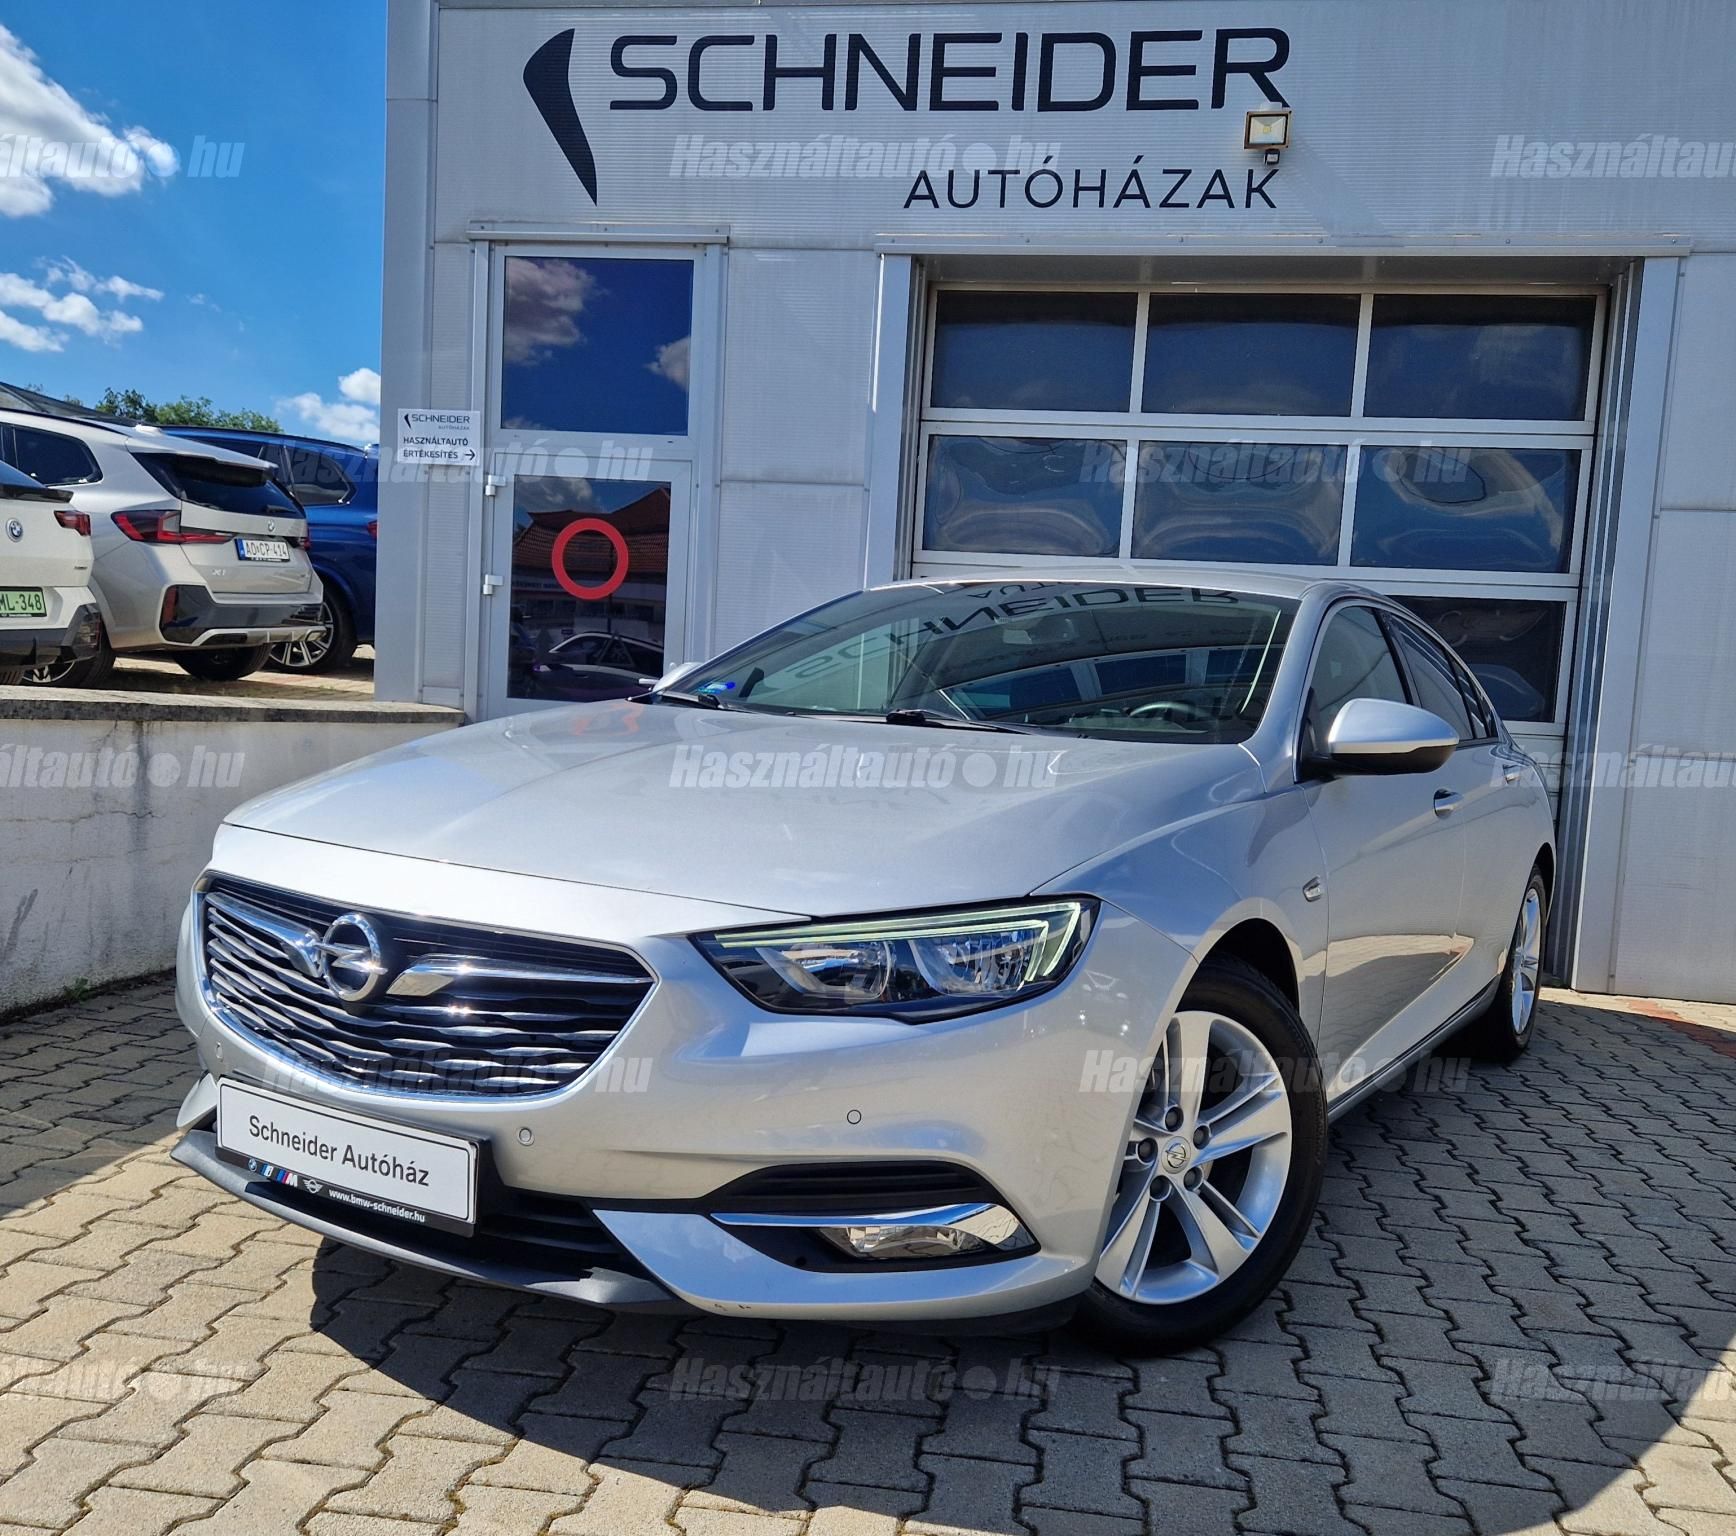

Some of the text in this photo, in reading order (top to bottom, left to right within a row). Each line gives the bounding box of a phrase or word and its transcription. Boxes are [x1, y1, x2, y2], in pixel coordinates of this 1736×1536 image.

[610, 27, 1291, 112] SCHNEIDER
[903, 155, 1279, 210] AUTÓHÁZAK
[411, 413, 471, 424] SCHNEIDER
[403, 434, 469, 447] HASZNÁLTAUTÓ
[403, 448, 459, 459] ÉRTÉKESÍTÉS
[248, 1114, 430, 1188] Schneider Autóház
[328, 1188, 426, 1223] www.bmw-schneider.hu
